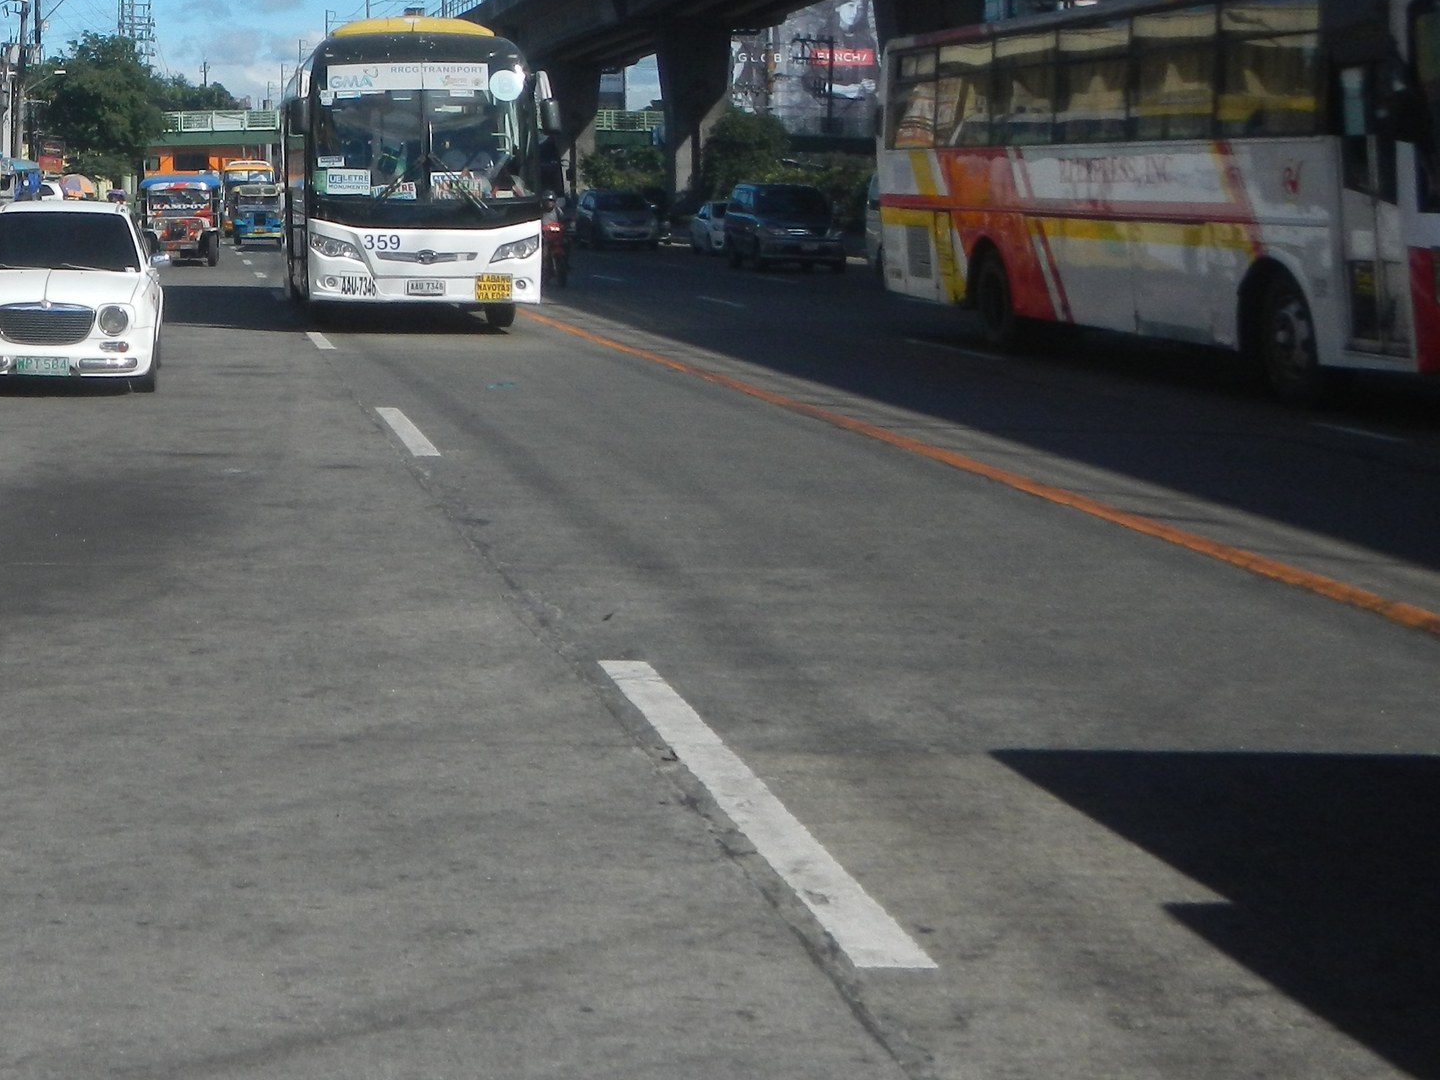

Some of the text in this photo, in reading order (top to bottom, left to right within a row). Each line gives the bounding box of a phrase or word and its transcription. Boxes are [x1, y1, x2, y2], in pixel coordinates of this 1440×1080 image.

[390, 66, 483, 74] RRCG TRANSPORT
[330, 74, 374, 89] GMA
[343, 174, 369, 182] LETRE
[152, 203, 206, 211] KAMPOY
[363, 234, 401, 251] 359
[476, 284, 510, 292] NAVOTAS
[476, 292, 490, 300] VIA
